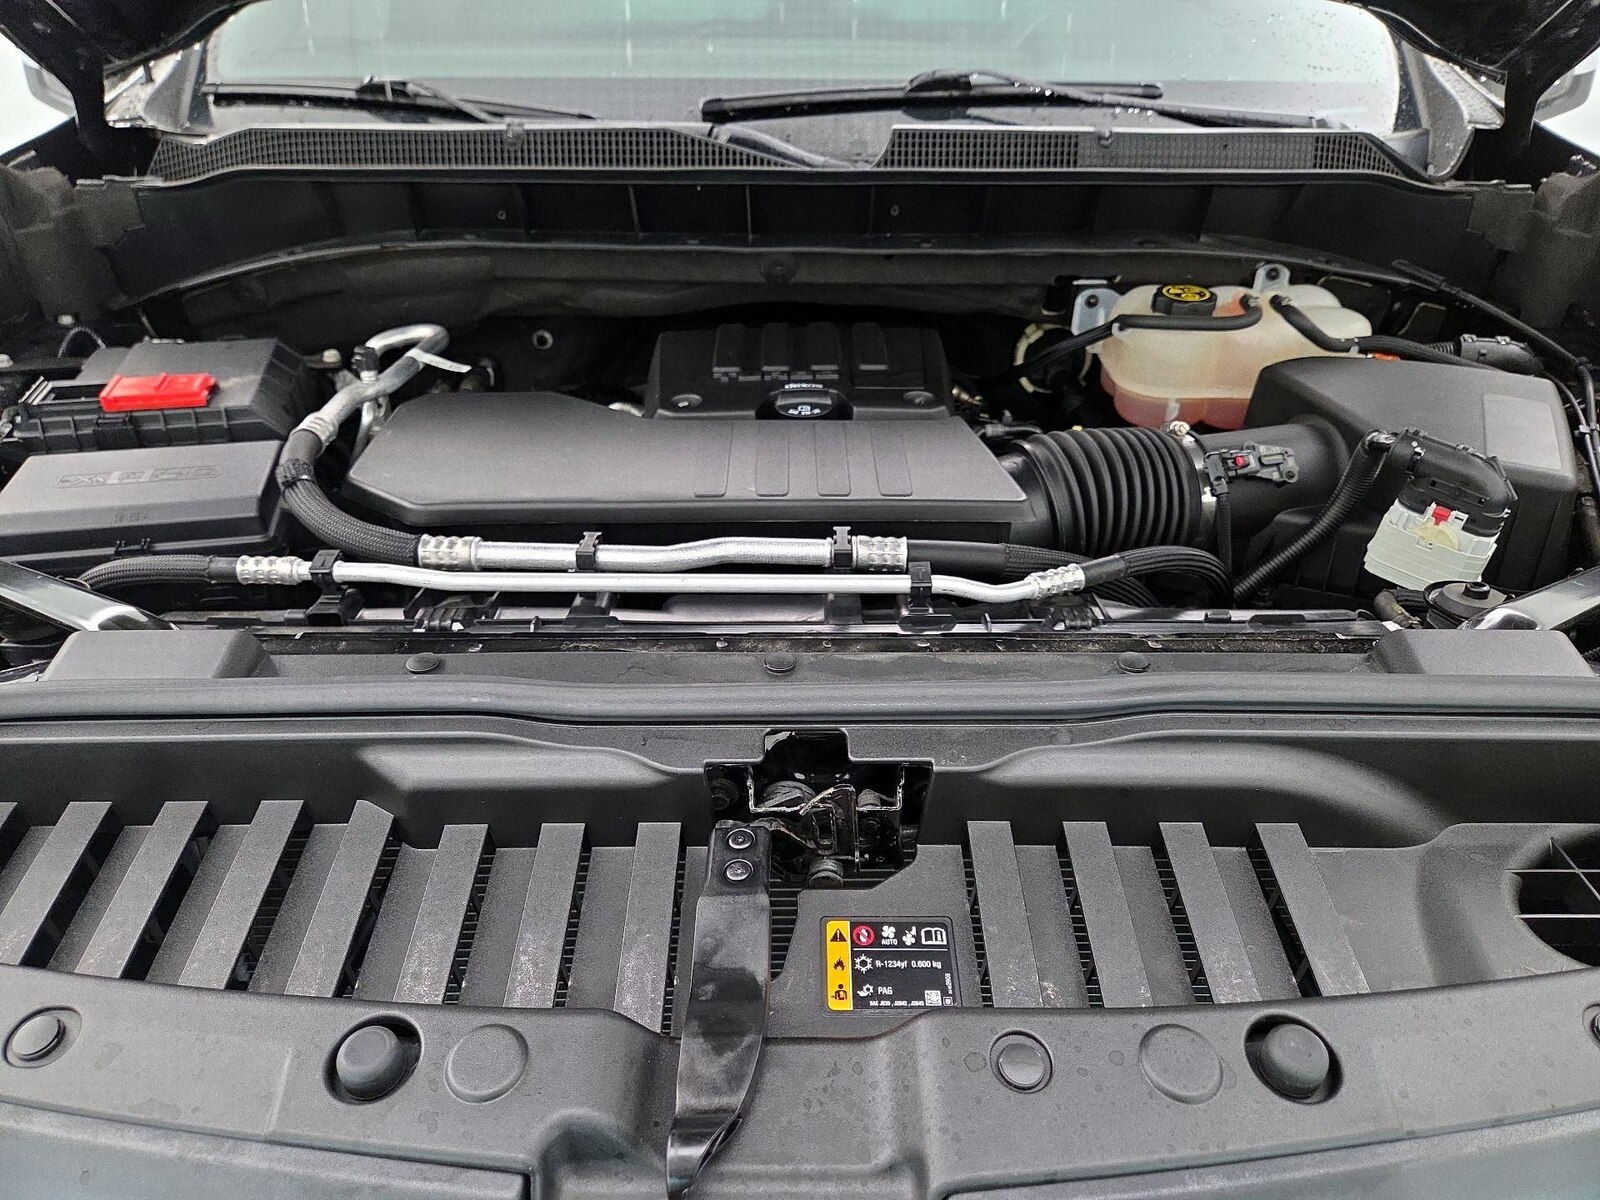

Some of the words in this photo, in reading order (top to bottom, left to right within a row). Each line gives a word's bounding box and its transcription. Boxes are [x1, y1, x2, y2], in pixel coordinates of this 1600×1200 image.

[881, 938, 898, 946] AUTO
[875, 960, 908, 969] R-1234yf
[911, 960, 931, 968] 0.600
[932, 960, 942, 969] kg
[878, 986, 893, 995] PAG
